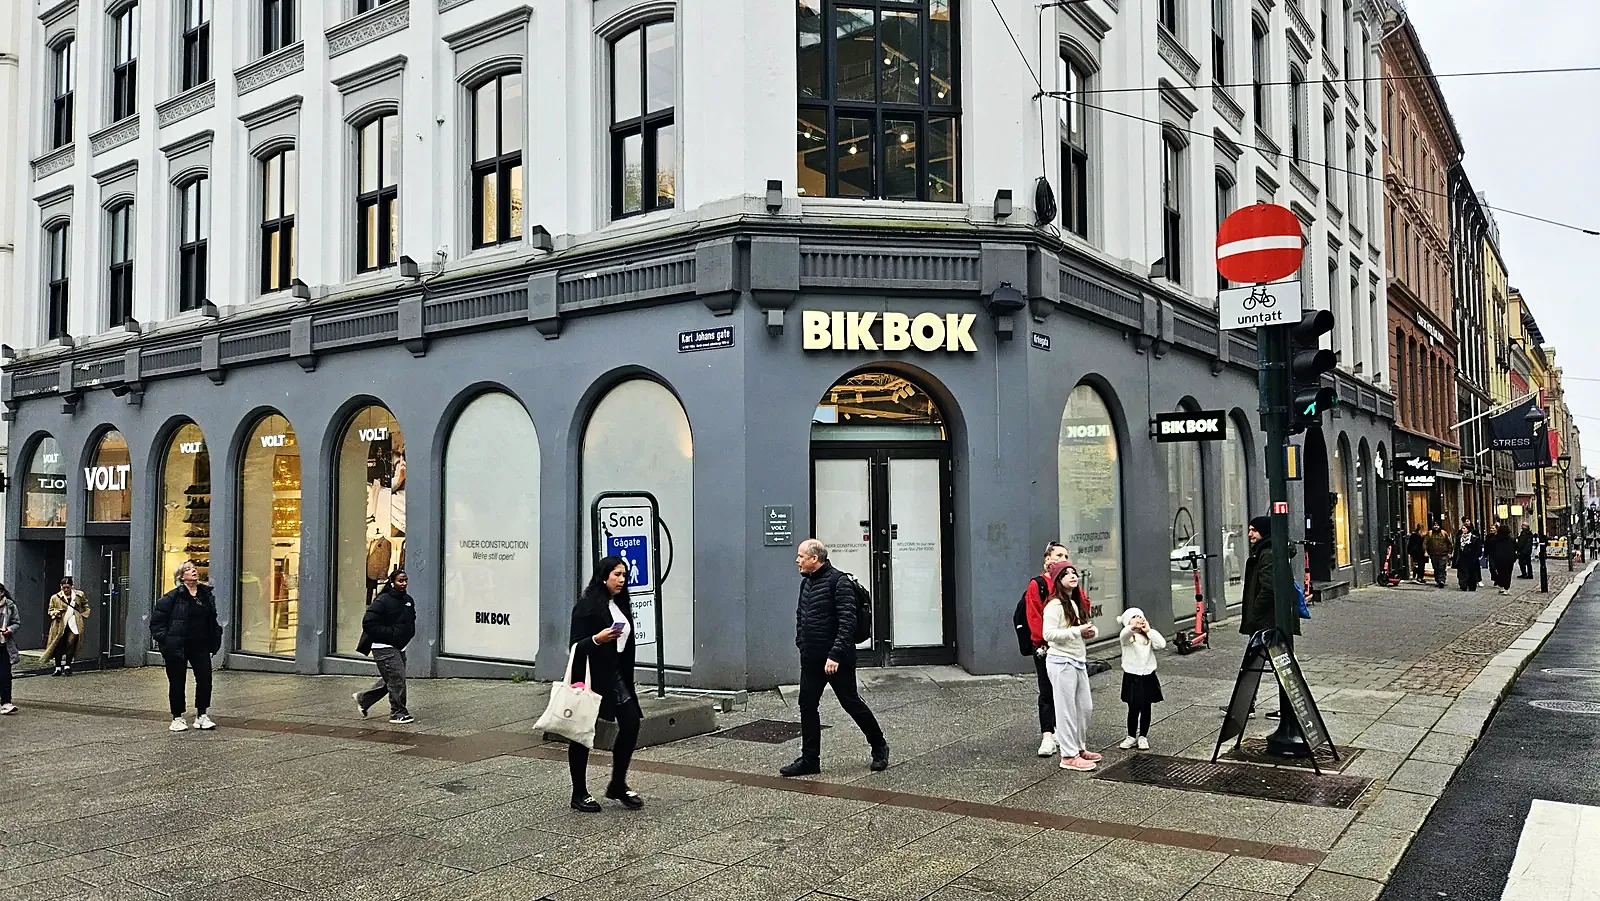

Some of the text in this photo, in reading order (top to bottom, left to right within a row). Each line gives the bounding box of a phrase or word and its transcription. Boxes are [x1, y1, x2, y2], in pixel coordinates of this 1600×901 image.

[1237, 310, 1282, 324] unntatt
[681, 329, 731, 343] Karl Johans gate
[802, 310, 978, 352] BIK BOK
[1161, 418, 1219, 434] BIK BOK
[260, 434, 286, 448] VOLT
[359, 427, 388, 442] VOLT
[179, 441, 202, 454] VOLT
[1493, 438, 1531, 447] STRESS
[42, 453, 59, 464] VOLT
[84, 464, 131, 491] VOLT
[609, 511, 644, 528] Sone
[459, 540, 529, 550] UNDER CONSTRUCTION
[613, 537, 641, 549] Gågate
[488, 552, 498, 561] still
[475, 611, 511, 626] BIK BOK
